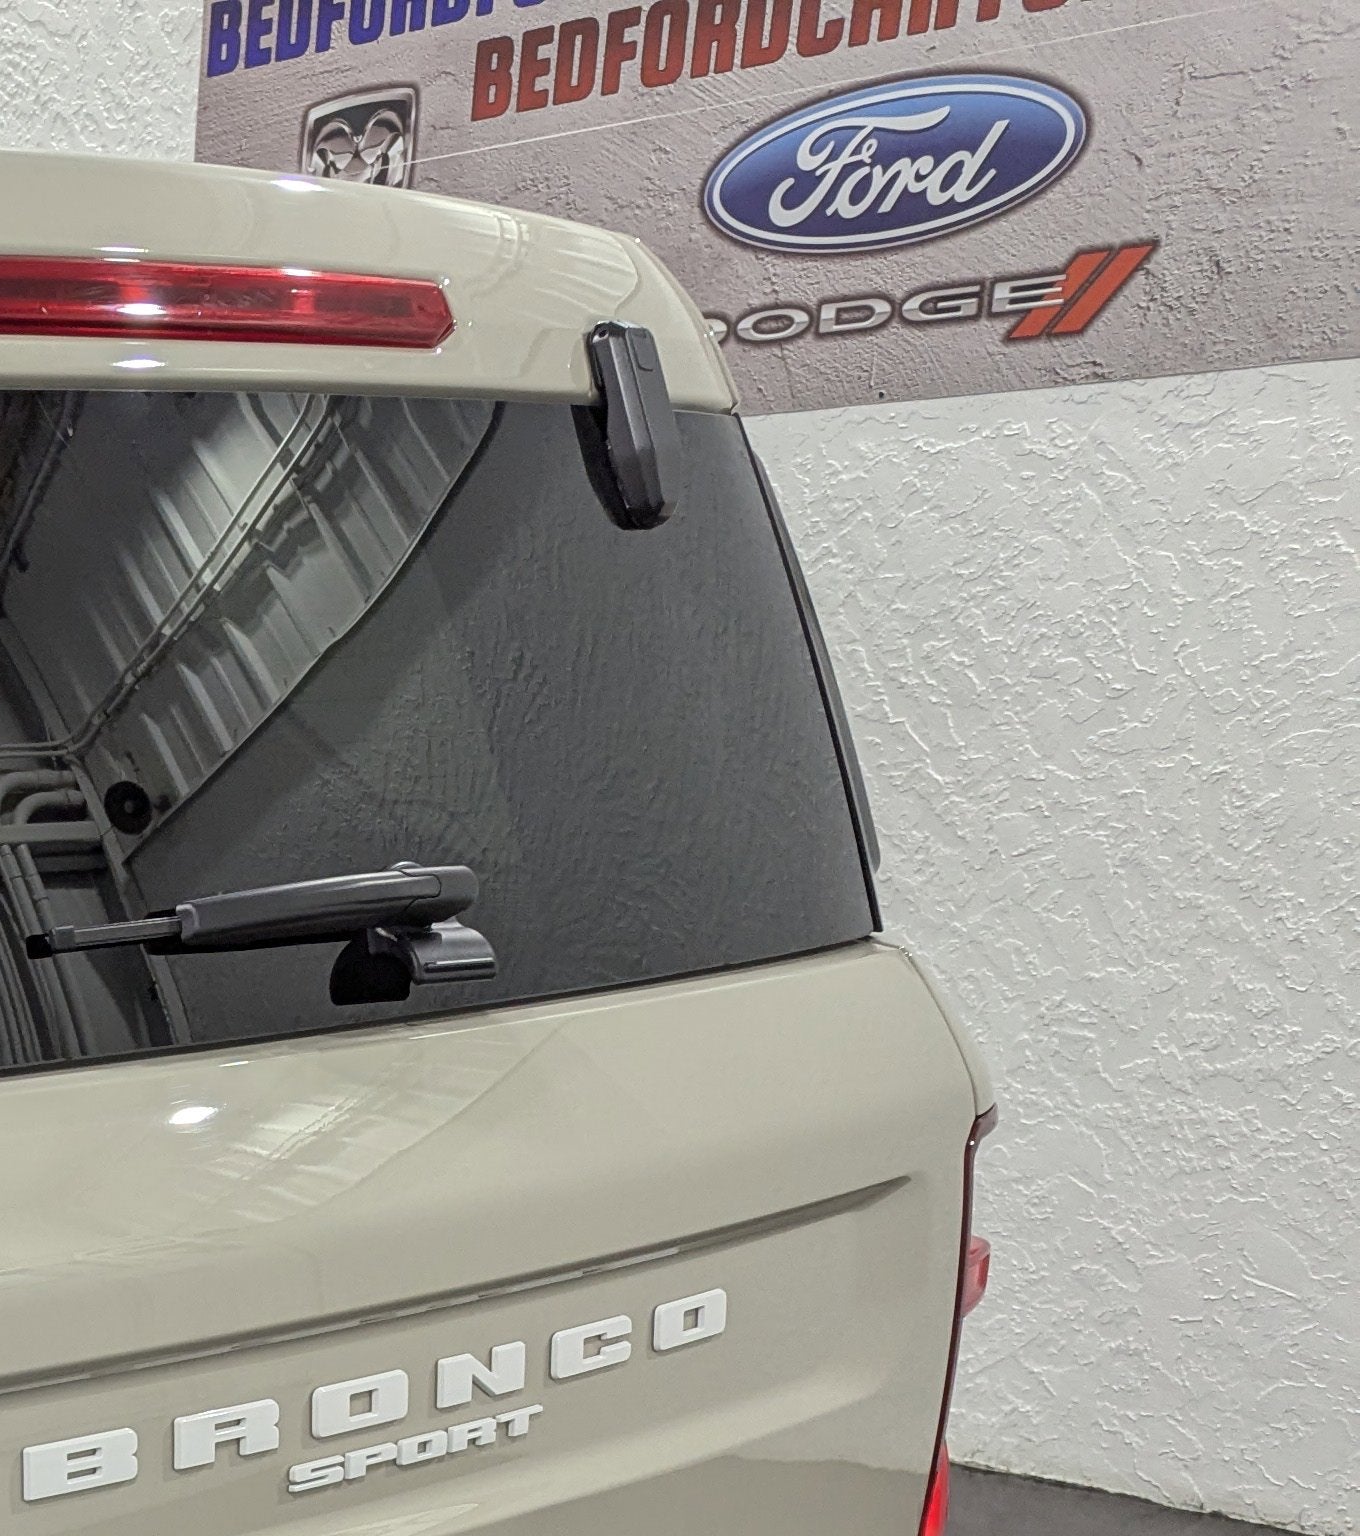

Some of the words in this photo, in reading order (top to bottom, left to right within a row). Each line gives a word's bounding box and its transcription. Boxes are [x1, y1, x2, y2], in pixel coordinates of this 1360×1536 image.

[768, 105, 1010, 228] Ford
[21, 1287, 728, 1502] BRONCO
[287, 1403, 544, 1496] SPORT
